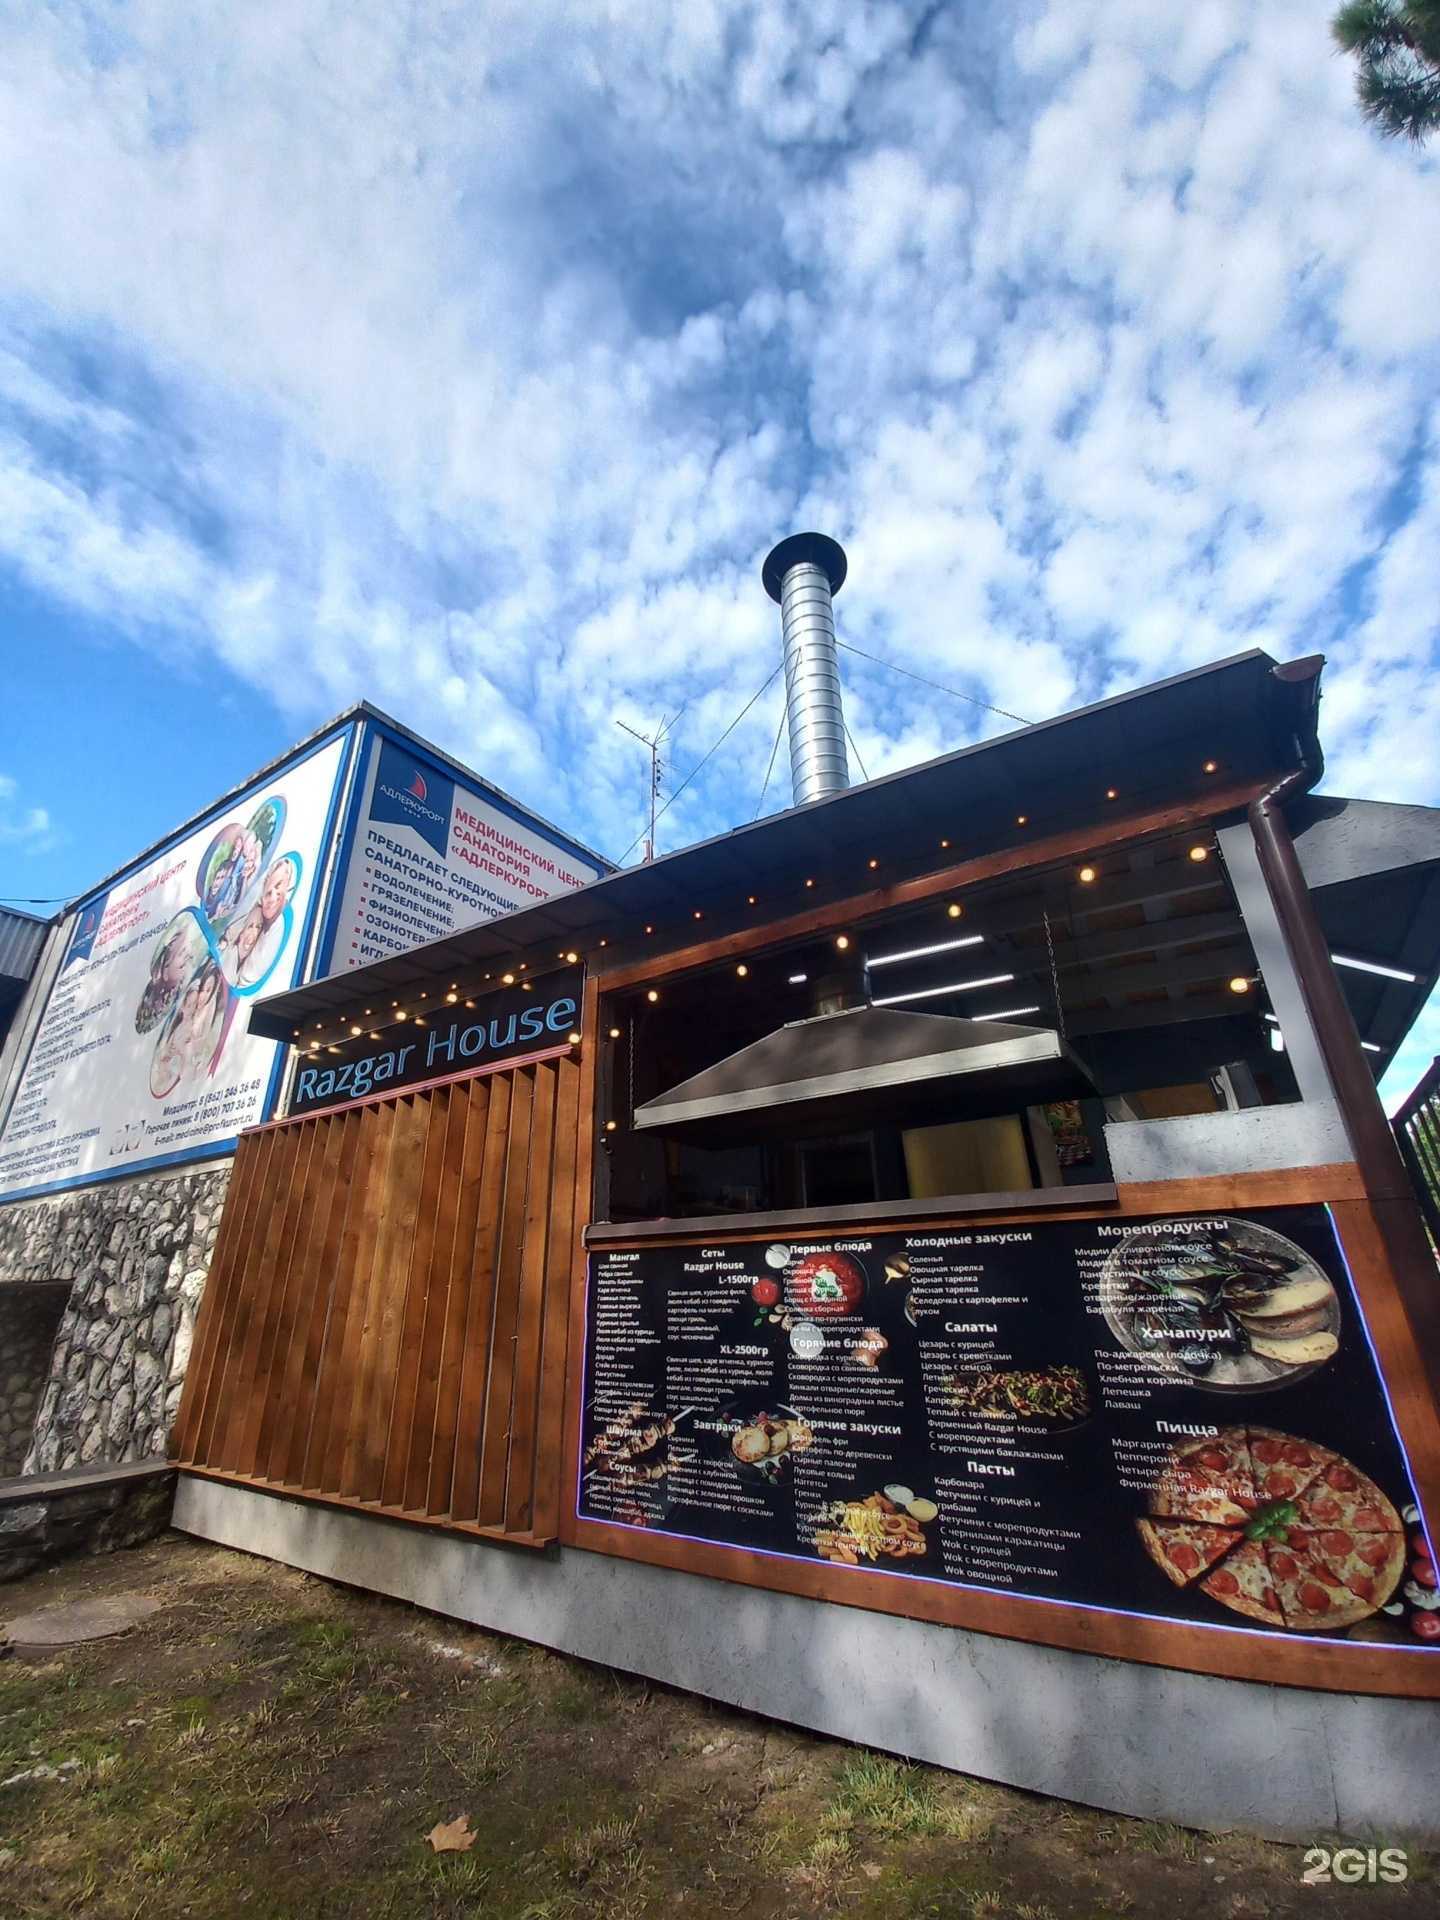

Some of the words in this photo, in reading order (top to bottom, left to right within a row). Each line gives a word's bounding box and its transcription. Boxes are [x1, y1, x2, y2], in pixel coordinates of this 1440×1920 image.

[379, 783, 446, 825] АДЛЕРКУРОРТ
[455, 807, 555, 874] МЕДИЦИНСКИЙ
[453, 826, 531, 877] САНАТОРИЯ
[368, 830, 449, 878] ПРЕДЛАГАЕТ
[451, 873, 520, 911] СЛЕДУЮЩИЕ
[373, 869, 454, 914] ВОДОЛЕЧЕНИЕ;
[371, 884, 455, 928] ГРЯЗЕЛЕЧЕНИЕ;
[366, 914, 431, 944] ОЗОНОТЕР
[296, 1043, 416, 1103] Razgar
[426, 998, 577, 1067] House
[1097, 1220, 1229, 1239] Морепродукты
[905, 1236, 972, 1248] Холодные
[975, 1232, 1032, 1245] закуски
[701, 1249, 725, 1258] Сеты
[790, 1245, 831, 1256] Первые
[834, 1242, 872, 1252] блюда
[1075, 1248, 1109, 1257] Мидии
[609, 1254, 640, 1262] Мангал
[1077, 1259, 1112, 1268] Мидии
[1123, 1256, 1175, 1266] томатном
[1178, 1255, 1209, 1265] соусе
[684, 1263, 714, 1273] Razgar
[716, 1262, 745, 1270] House
[910, 1266, 948, 1274] Овощная
[950, 1265, 984, 1273] тарелка
[719, 1275, 759, 1286] L-1500гр
[1080, 1270, 1140, 1279] Лангустины
[911, 1277, 943, 1285] Сырная
[1081, 1282, 1130, 1291] Креветки
[945, 1286, 979, 1294] тарелка
[913, 1297, 958, 1305] Селедочка
[966, 1296, 1020, 1305] картофелем
[1084, 1293, 1186, 1302] отварные/жареные
[915, 1308, 940, 1316] луком
[1086, 1305, 1135, 1315] Барабуля
[1137, 1305, 1184, 1314] жареная
[945, 1322, 997, 1332] Салаты
[1142, 1327, 1231, 1341] Хачапури
[793, 1338, 841, 1350] Горячие
[844, 1338, 884, 1350] блюда
[919, 1340, 949, 1349] Цезарь
[957, 1341, 995, 1349] курицей
[720, 1345, 769, 1358] XL-2500гр
[920, 1351, 950, 1360] Цезарь
[959, 1353, 1012, 1361] креветками
[1094, 1350, 1163, 1360] По-аджарски
[1166, 1350, 1222, 1361] (лодочка)
[921, 1363, 952, 1371] Цезарь
[960, 1364, 993, 1373] семгой
[1097, 1362, 1179, 1372] По-мегрельски
[837, 1376, 904, 1386] морепродуктами
[1099, 1375, 1144, 1384] Хлебная
[1147, 1377, 1194, 1386] корзина
[923, 1384, 970, 1393] Греческий
[1102, 1387, 1151, 1397] Лепешка
[1105, 1400, 1141, 1410] Лаваш
[927, 1407, 959, 1417] Теплый
[968, 1411, 1018, 1420] телятиной
[606, 1425, 642, 1437] Шаурма
[693, 1420, 742, 1433] Завтраки
[798, 1417, 848, 1431] Горячие
[850, 1422, 902, 1435] закуски
[928, 1419, 982, 1430] Фирменный
[984, 1423, 1014, 1433] Razgar
[1017, 1425, 1048, 1434] House
[1156, 1420, 1218, 1437] Пицца
[937, 1433, 1016, 1445] морепродуктами
[1112, 1438, 1173, 1450] Маргарита
[939, 1445, 994, 1456] хрустящими
[996, 1447, 1064, 1460] баклажанами
[1114, 1452, 1180, 1464] Пепперони
[609, 1462, 637, 1474] Соусы
[967, 1461, 1015, 1476] Пасты
[1116, 1465, 1159, 1477] Четыре
[1162, 1470, 1191, 1479] сыра
[934, 1477, 985, 1489] Карбонара
[1119, 1478, 1187, 1492] Фирменная
[1190, 1483, 1228, 1497] Razgar
[1232, 1488, 1272, 1500] House
[936, 1489, 981, 1501] Фетучини
[990, 1496, 1032, 1507] курицей
[938, 1502, 977, 1513] грибами
[939, 1514, 985, 1527] Фетучини
[994, 1522, 1081, 1538] морепродуктами
[948, 1529, 1002, 1542] чернилами
[1004, 1536, 1065, 1551] каракатицы
[941, 1539, 961, 1549] Wok
[970, 1544, 1012, 1557] курицей
[943, 1552, 963, 1562] Wok
[972, 1557, 1058, 1577] морепродуктами
[944, 1565, 965, 1575] Wok
[967, 1569, 1013, 1583] овощной
